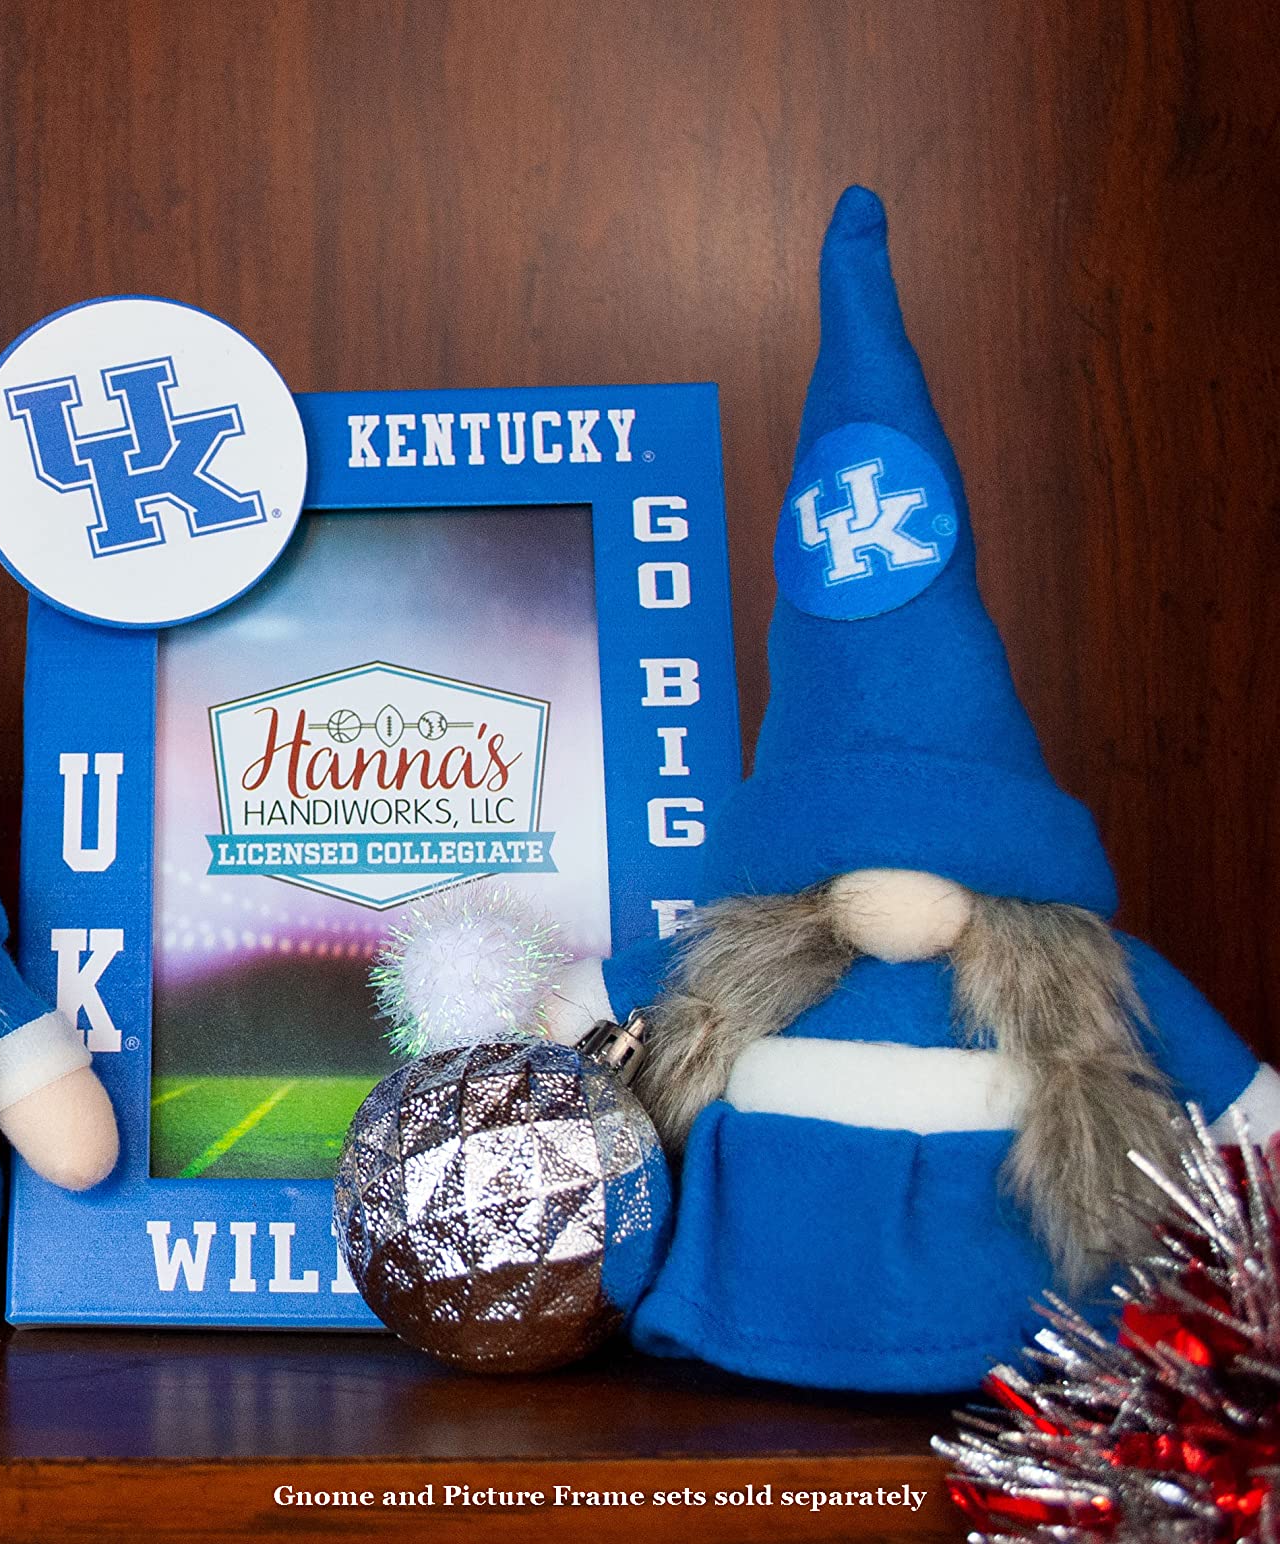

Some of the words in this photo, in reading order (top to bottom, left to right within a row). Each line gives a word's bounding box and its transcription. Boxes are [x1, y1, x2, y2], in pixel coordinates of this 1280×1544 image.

[3, 356, 268, 559] UK
[347, 409, 636, 468] KENTUCKY
[633, 496, 691, 609] GO
[791, 458, 941, 587] UK
[242, 707, 523, 799] Hanna's
[640, 658, 705, 847] BIG
[218, 843, 359, 866] LICENSED
[367, 841, 544, 865] COLLEGIATE
[244, 798, 458, 828] HANDIWORKS,
[471, 798, 516, 824] LLC
